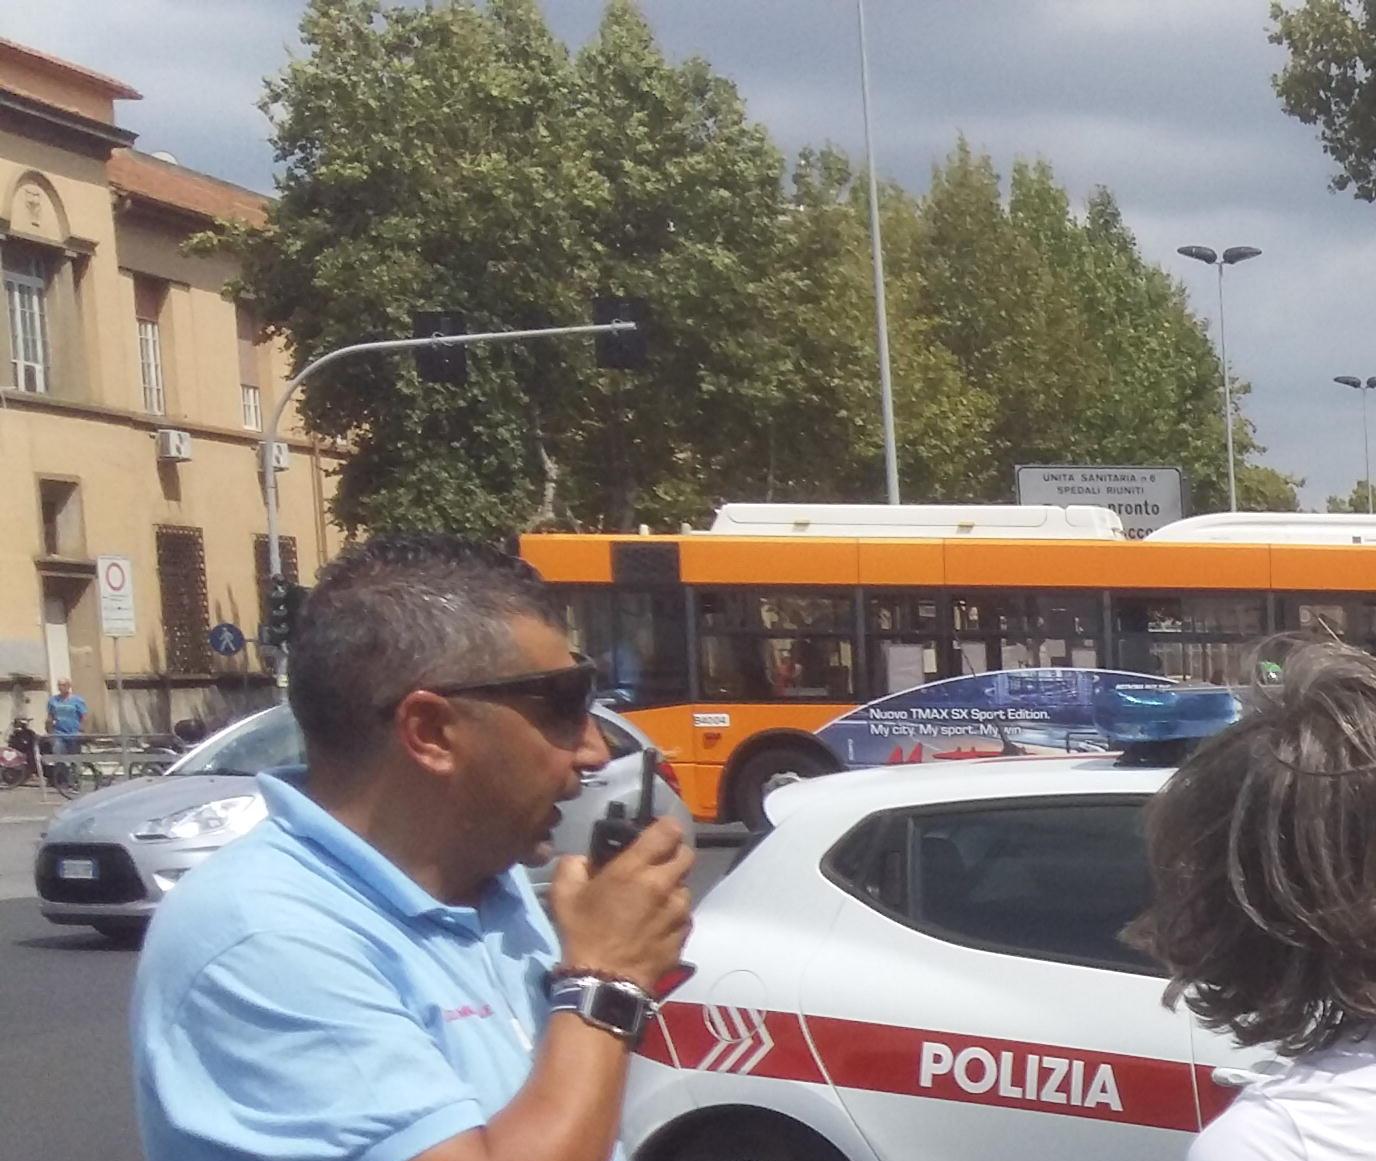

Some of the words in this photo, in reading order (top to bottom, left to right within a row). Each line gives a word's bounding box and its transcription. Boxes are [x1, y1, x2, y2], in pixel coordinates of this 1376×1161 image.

[1080, 473, 1136, 482] SANITARIA
[1057, 486, 1101, 495] SPEDALI
[1106, 486, 1144, 495] RIUNITI
[869, 708, 908, 720] Nuovo
[910, 708, 949, 720] TMAX
[951, 708, 969, 720] SX
[970, 708, 1005, 723] Sport
[1007, 708, 1051, 720] Edition.
[870, 724, 890, 737] My
[919, 724, 938, 737] My
[979, 724, 999, 737] My
[919, 1041, 1123, 1112] POLIZIA
